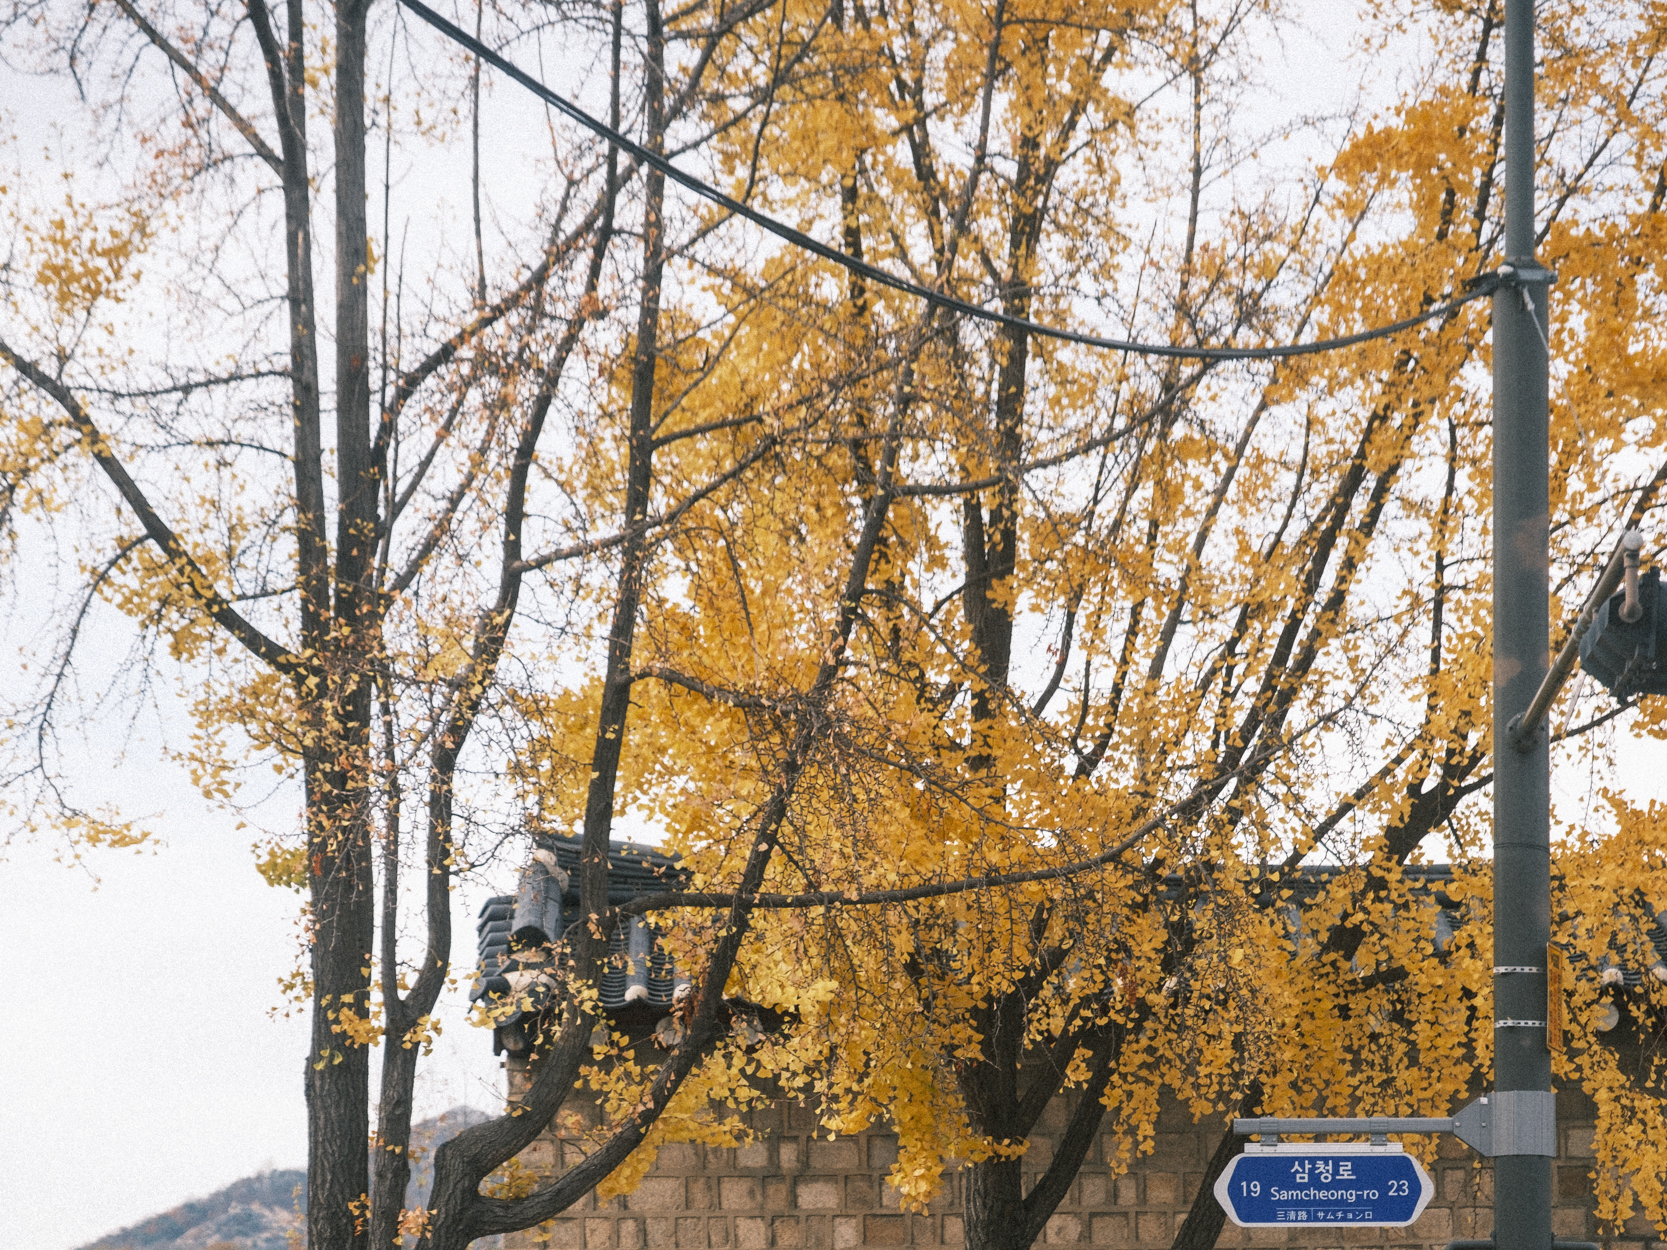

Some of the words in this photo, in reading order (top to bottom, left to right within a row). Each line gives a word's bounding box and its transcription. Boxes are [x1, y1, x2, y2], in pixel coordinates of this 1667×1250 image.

[1290, 1160, 1357, 1183] 삼청로
[1240, 1180, 1261, 1197] 19
[1270, 1187, 1379, 1202] Samcheong-ro
[1387, 1180, 1409, 1196] 23
[1276, 1211, 1308, 1221] 三清路
